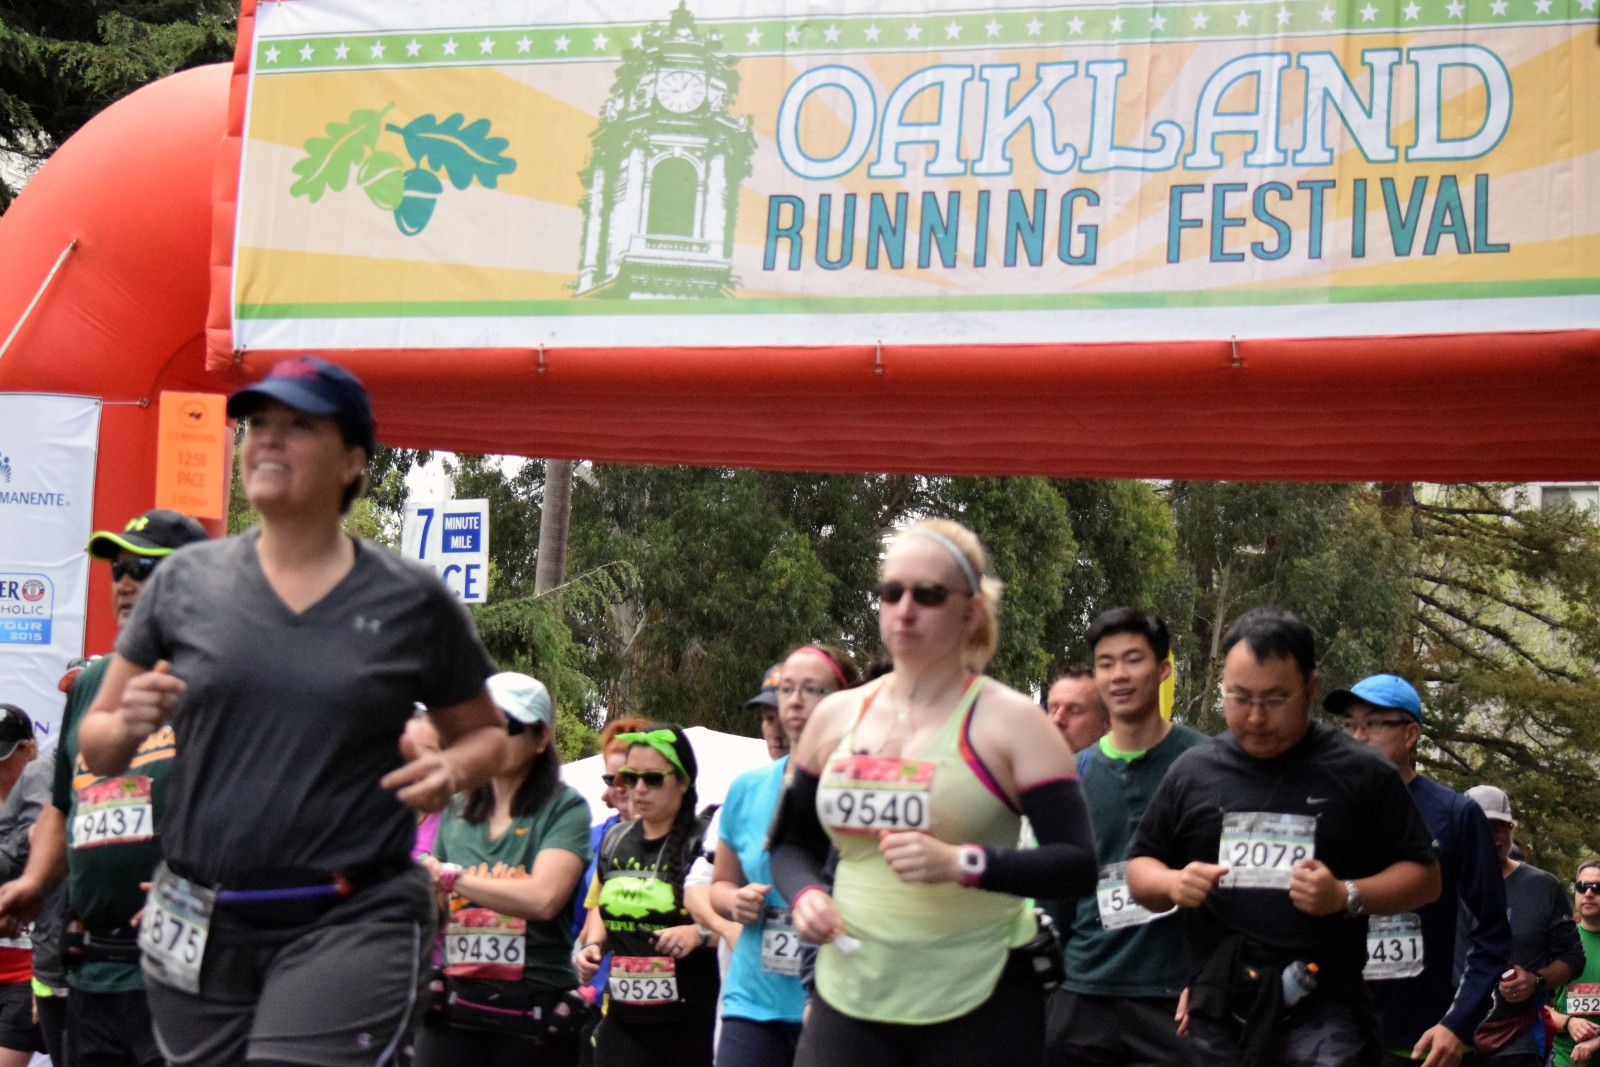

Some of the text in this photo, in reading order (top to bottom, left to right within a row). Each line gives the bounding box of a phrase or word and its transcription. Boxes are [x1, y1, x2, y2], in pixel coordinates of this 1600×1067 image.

[776, 43, 1513, 180] OAKLAND
[763, 173, 1510, 271] RUNNING FESTIVAL
[417, 507, 434, 559] 7
[444, 516, 480, 530] MINUTE
[450, 535, 472, 549] MILE
[441, 563, 481, 599] CE
[1, 604, 44, 615] HOLIC
[10, 632, 43, 641] 2015
[837, 791, 923, 827] 9540
[83, 806, 146, 841] 9437
[1233, 841, 1307, 868] 2078
[457, 935, 521, 962] 9436
[1366, 937, 1418, 962] 431
[619, 979, 674, 999] 9523
[1572, 998, 1600, 1012] 952
